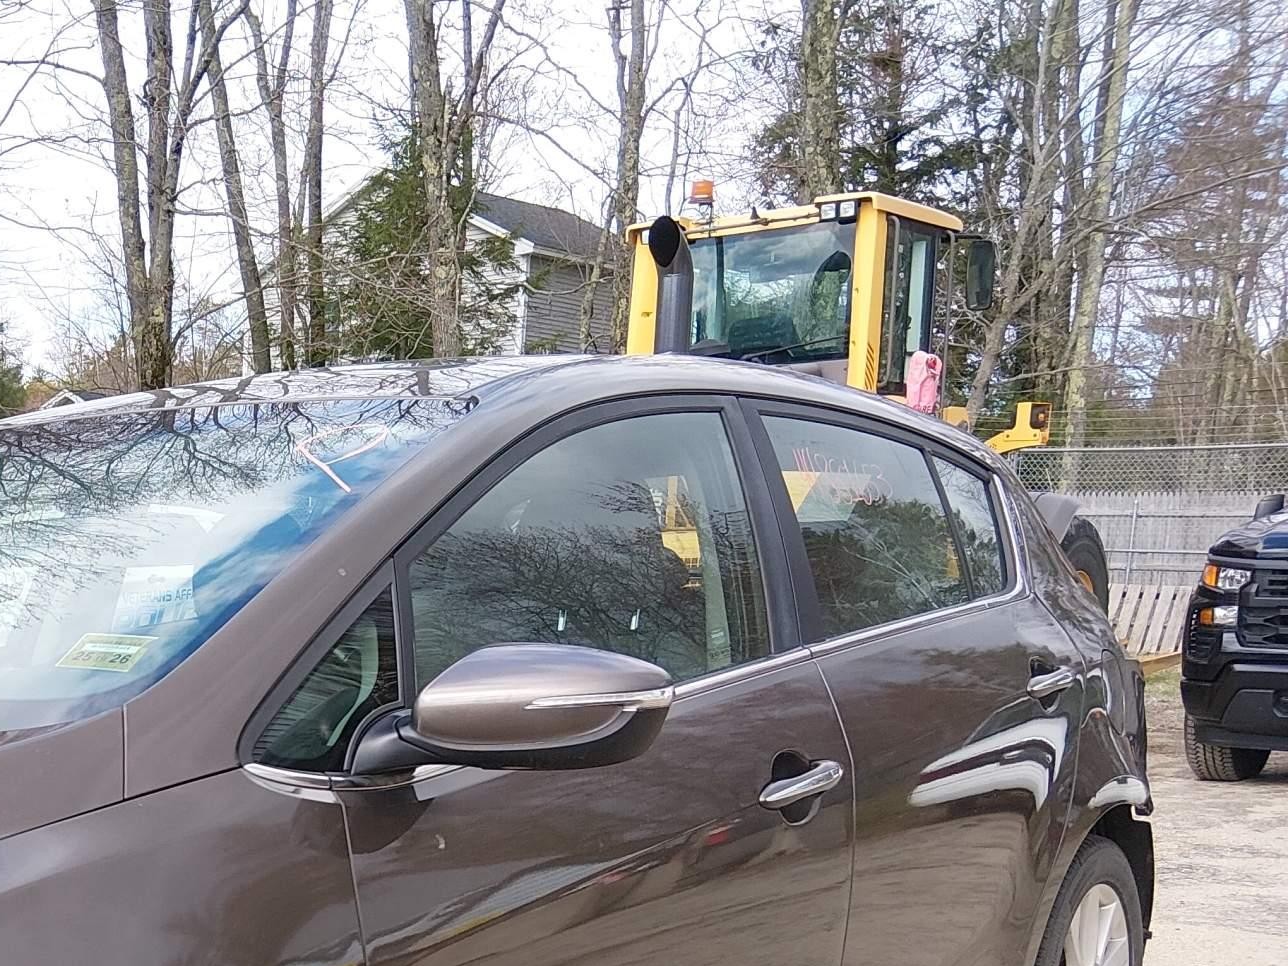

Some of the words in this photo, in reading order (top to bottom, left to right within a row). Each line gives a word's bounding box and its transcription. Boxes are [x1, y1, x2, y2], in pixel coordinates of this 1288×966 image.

[174, 588, 193, 602] AFF
[72, 650, 93, 661] 25
[109, 653, 132, 664] 26
